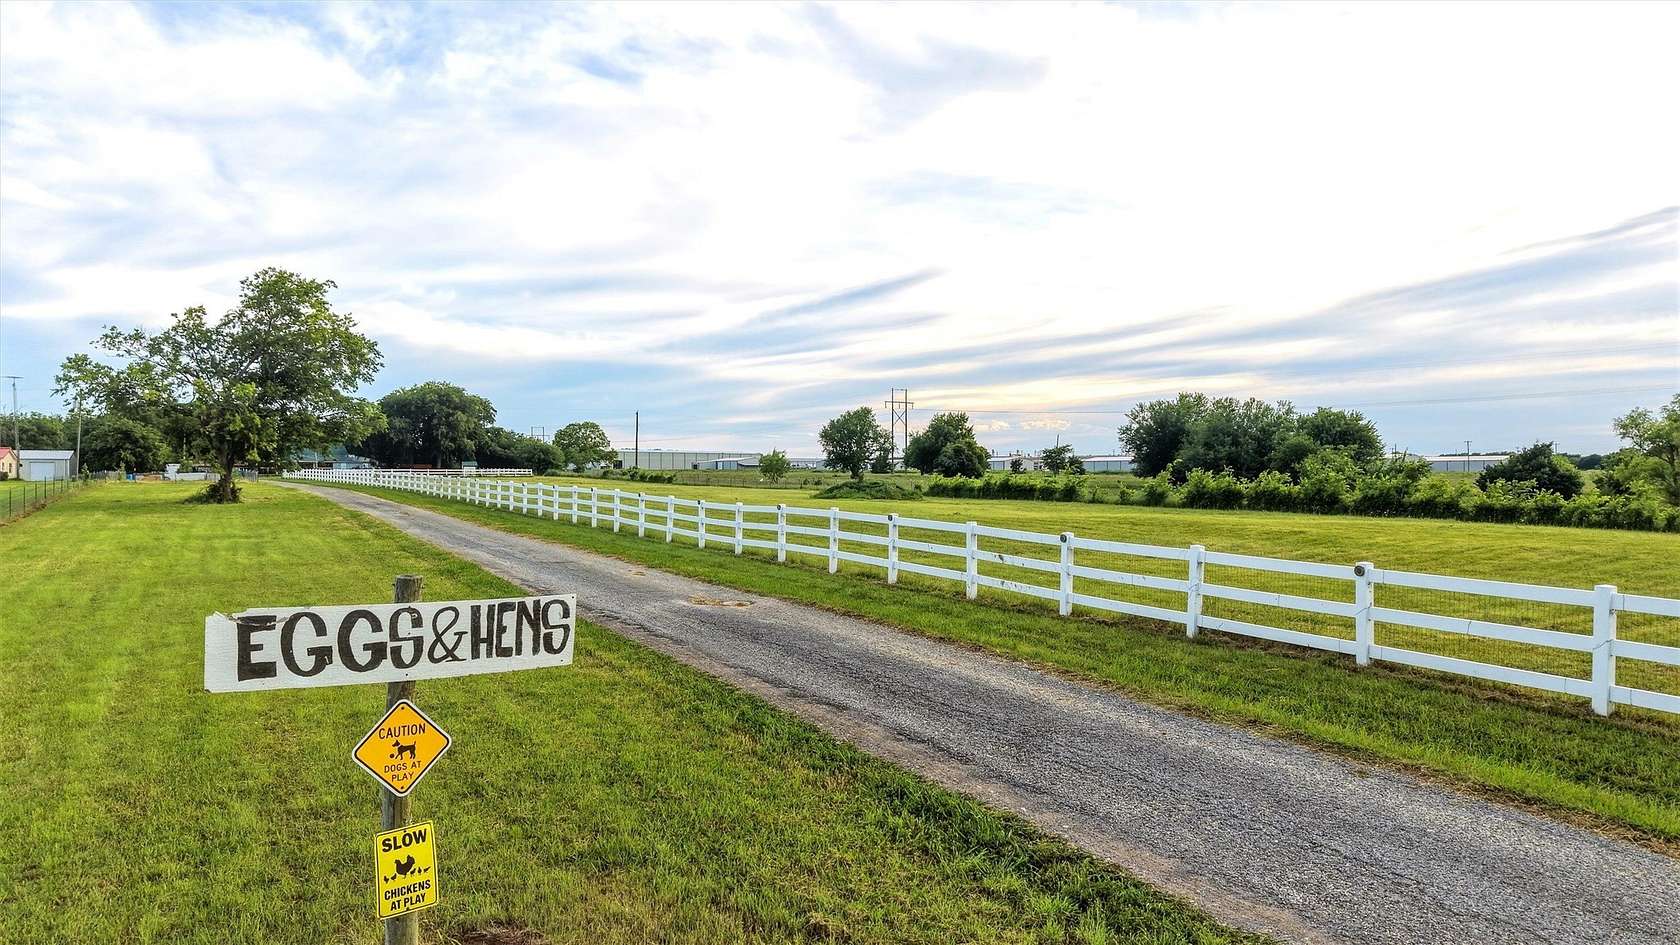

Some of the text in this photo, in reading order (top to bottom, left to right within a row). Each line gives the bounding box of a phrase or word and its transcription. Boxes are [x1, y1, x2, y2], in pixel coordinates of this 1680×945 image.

[379, 723, 426, 740] CAUTION
[384, 760, 422, 774] DOGS AT
[391, 771, 415, 782] PLAY
[382, 828, 427, 853] SLOW
[384, 879, 431, 901] CHICKENS
[390, 892, 426, 912] AT PLAY
